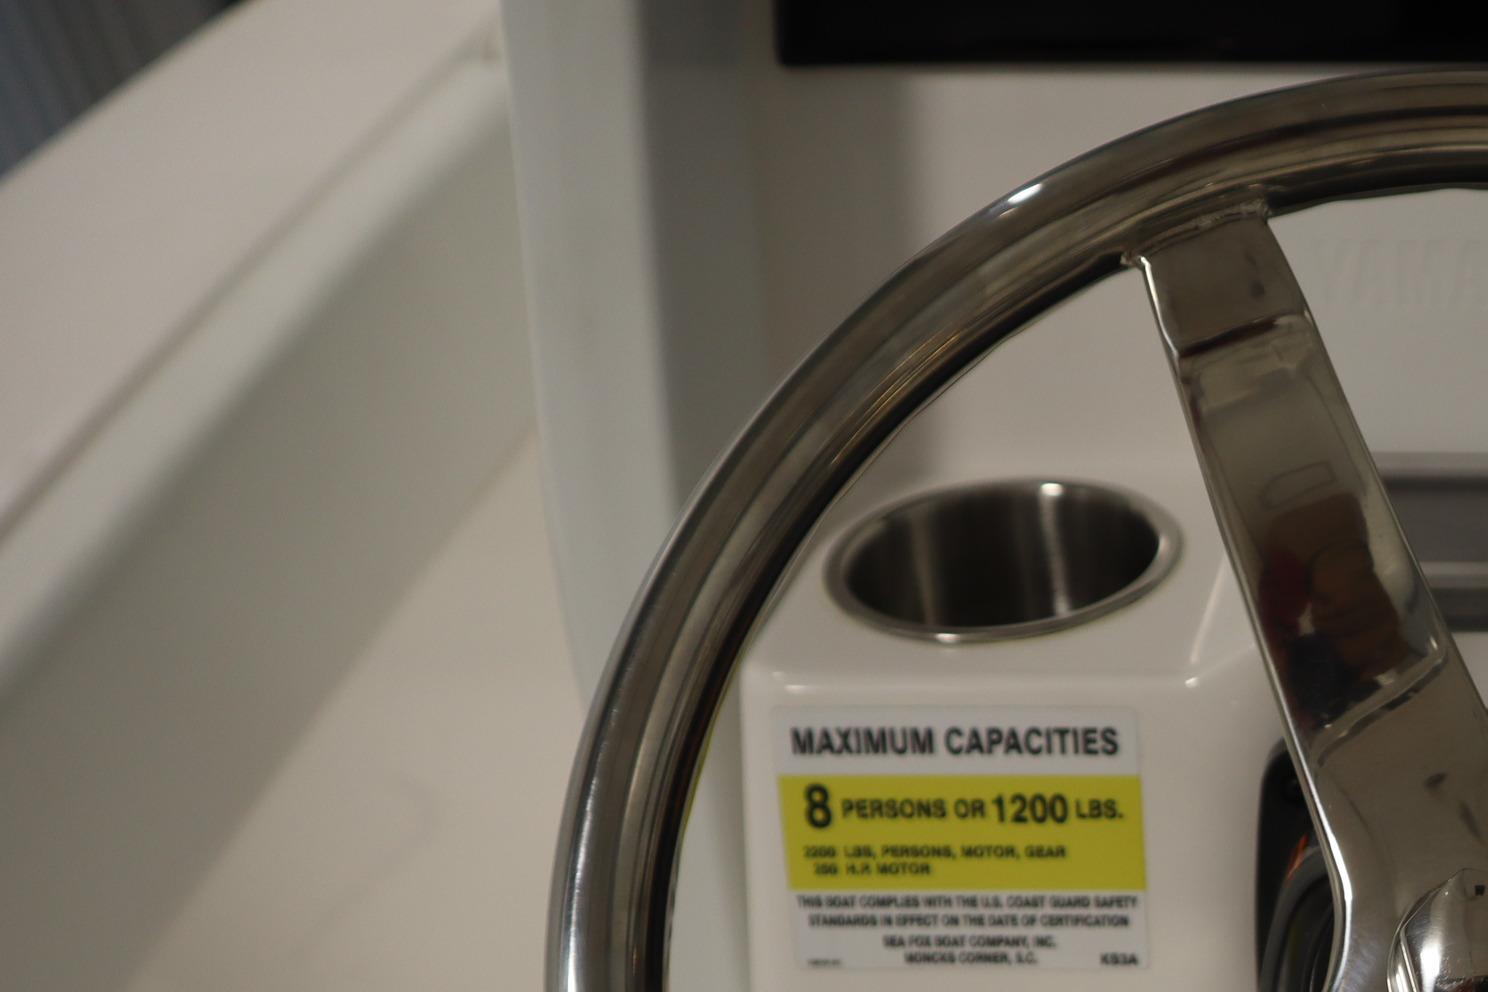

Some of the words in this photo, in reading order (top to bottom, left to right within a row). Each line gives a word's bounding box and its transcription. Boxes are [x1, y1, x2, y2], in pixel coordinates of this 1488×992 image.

[791, 728, 934, 755] MAXIMUM
[944, 728, 1118, 755] CAPACITIES
[804, 784, 832, 828] 8
[842, 799, 946, 819] PERSONS
[954, 799, 985, 818] OR
[992, 794, 1068, 823] 1200
[1076, 801, 1123, 819] LBS.
[882, 846, 953, 859] PERSONS,
[961, 846, 1019, 859] MOTOR,
[1026, 846, 1066, 859] GEAR
[877, 864, 931, 875] MOTOR
[826, 896, 855, 909] BOAT
[859, 896, 919, 909] COMPLIES
[924, 896, 952, 909] WITH
[957, 896, 977, 909] THE
[1008, 896, 1045, 909] COAST
[1049, 896, 1090, 909] GUARD
[1094, 896, 1137, 909] SAFETY
[809, 915, 877, 927] STANDARDS
[896, 915, 939, 927] EFFECT
[942, 915, 959, 927] ON
[963, 915, 984, 927] THE
[988, 915, 1018, 927] DATE
[1022, 915, 1037, 927] OF
[1040, 915, 1129, 927] CERTIFICATION
[935, 937, 966, 948] BOAT
